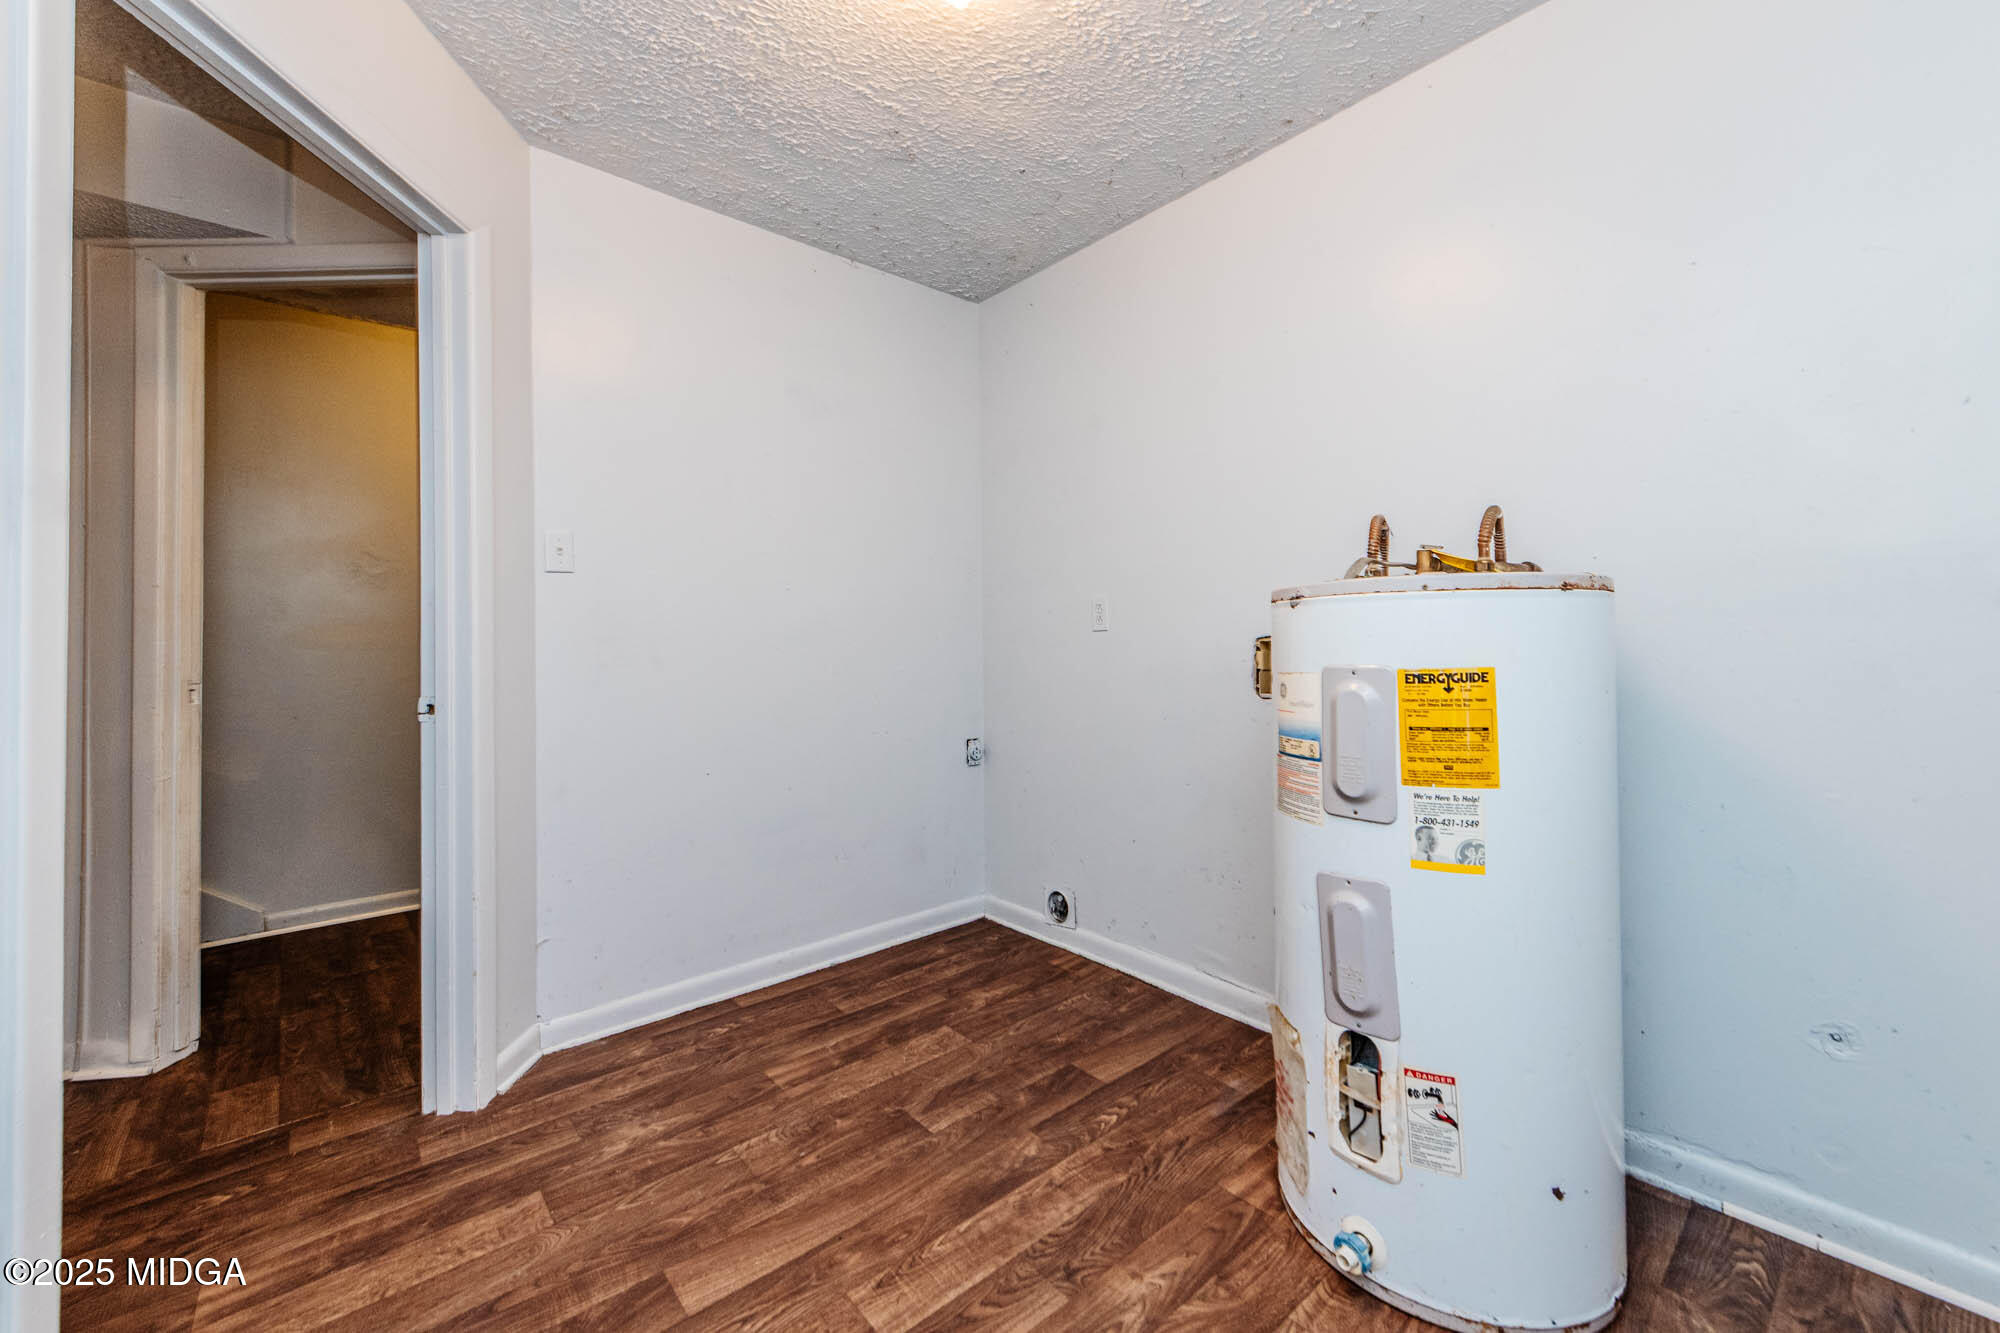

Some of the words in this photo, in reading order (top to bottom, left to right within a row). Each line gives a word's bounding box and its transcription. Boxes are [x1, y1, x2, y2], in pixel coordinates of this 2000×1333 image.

[1413, 792, 1432, 800] We're
[1434, 793, 1451, 802] Here
[1415, 816, 1480, 828] 1-800-431-1549
[1415, 1070, 1453, 1084] DANGER
